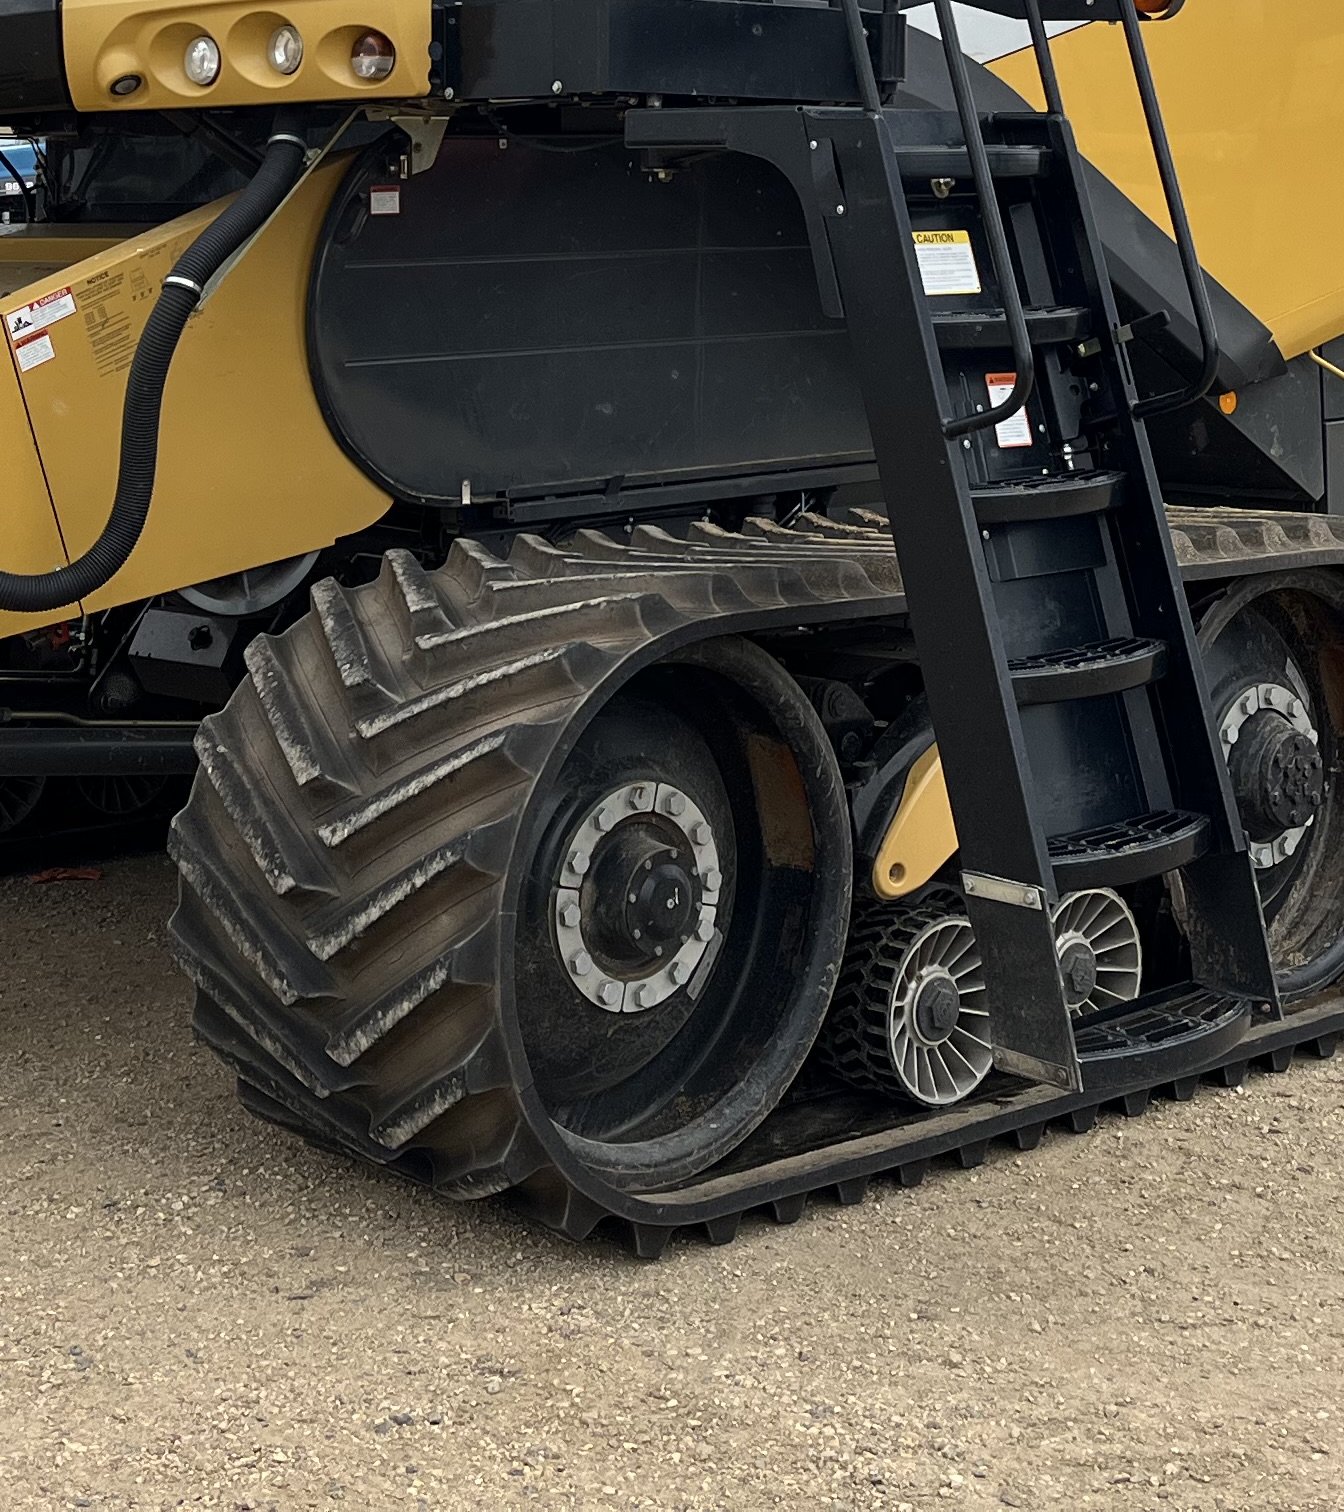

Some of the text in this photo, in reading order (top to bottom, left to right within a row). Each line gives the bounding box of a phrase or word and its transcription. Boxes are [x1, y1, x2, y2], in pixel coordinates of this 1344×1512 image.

[916, 233, 955, 244] CAUTION
[86, 270, 110, 286] NOTICE
[39, 288, 68, 307] DANGER
